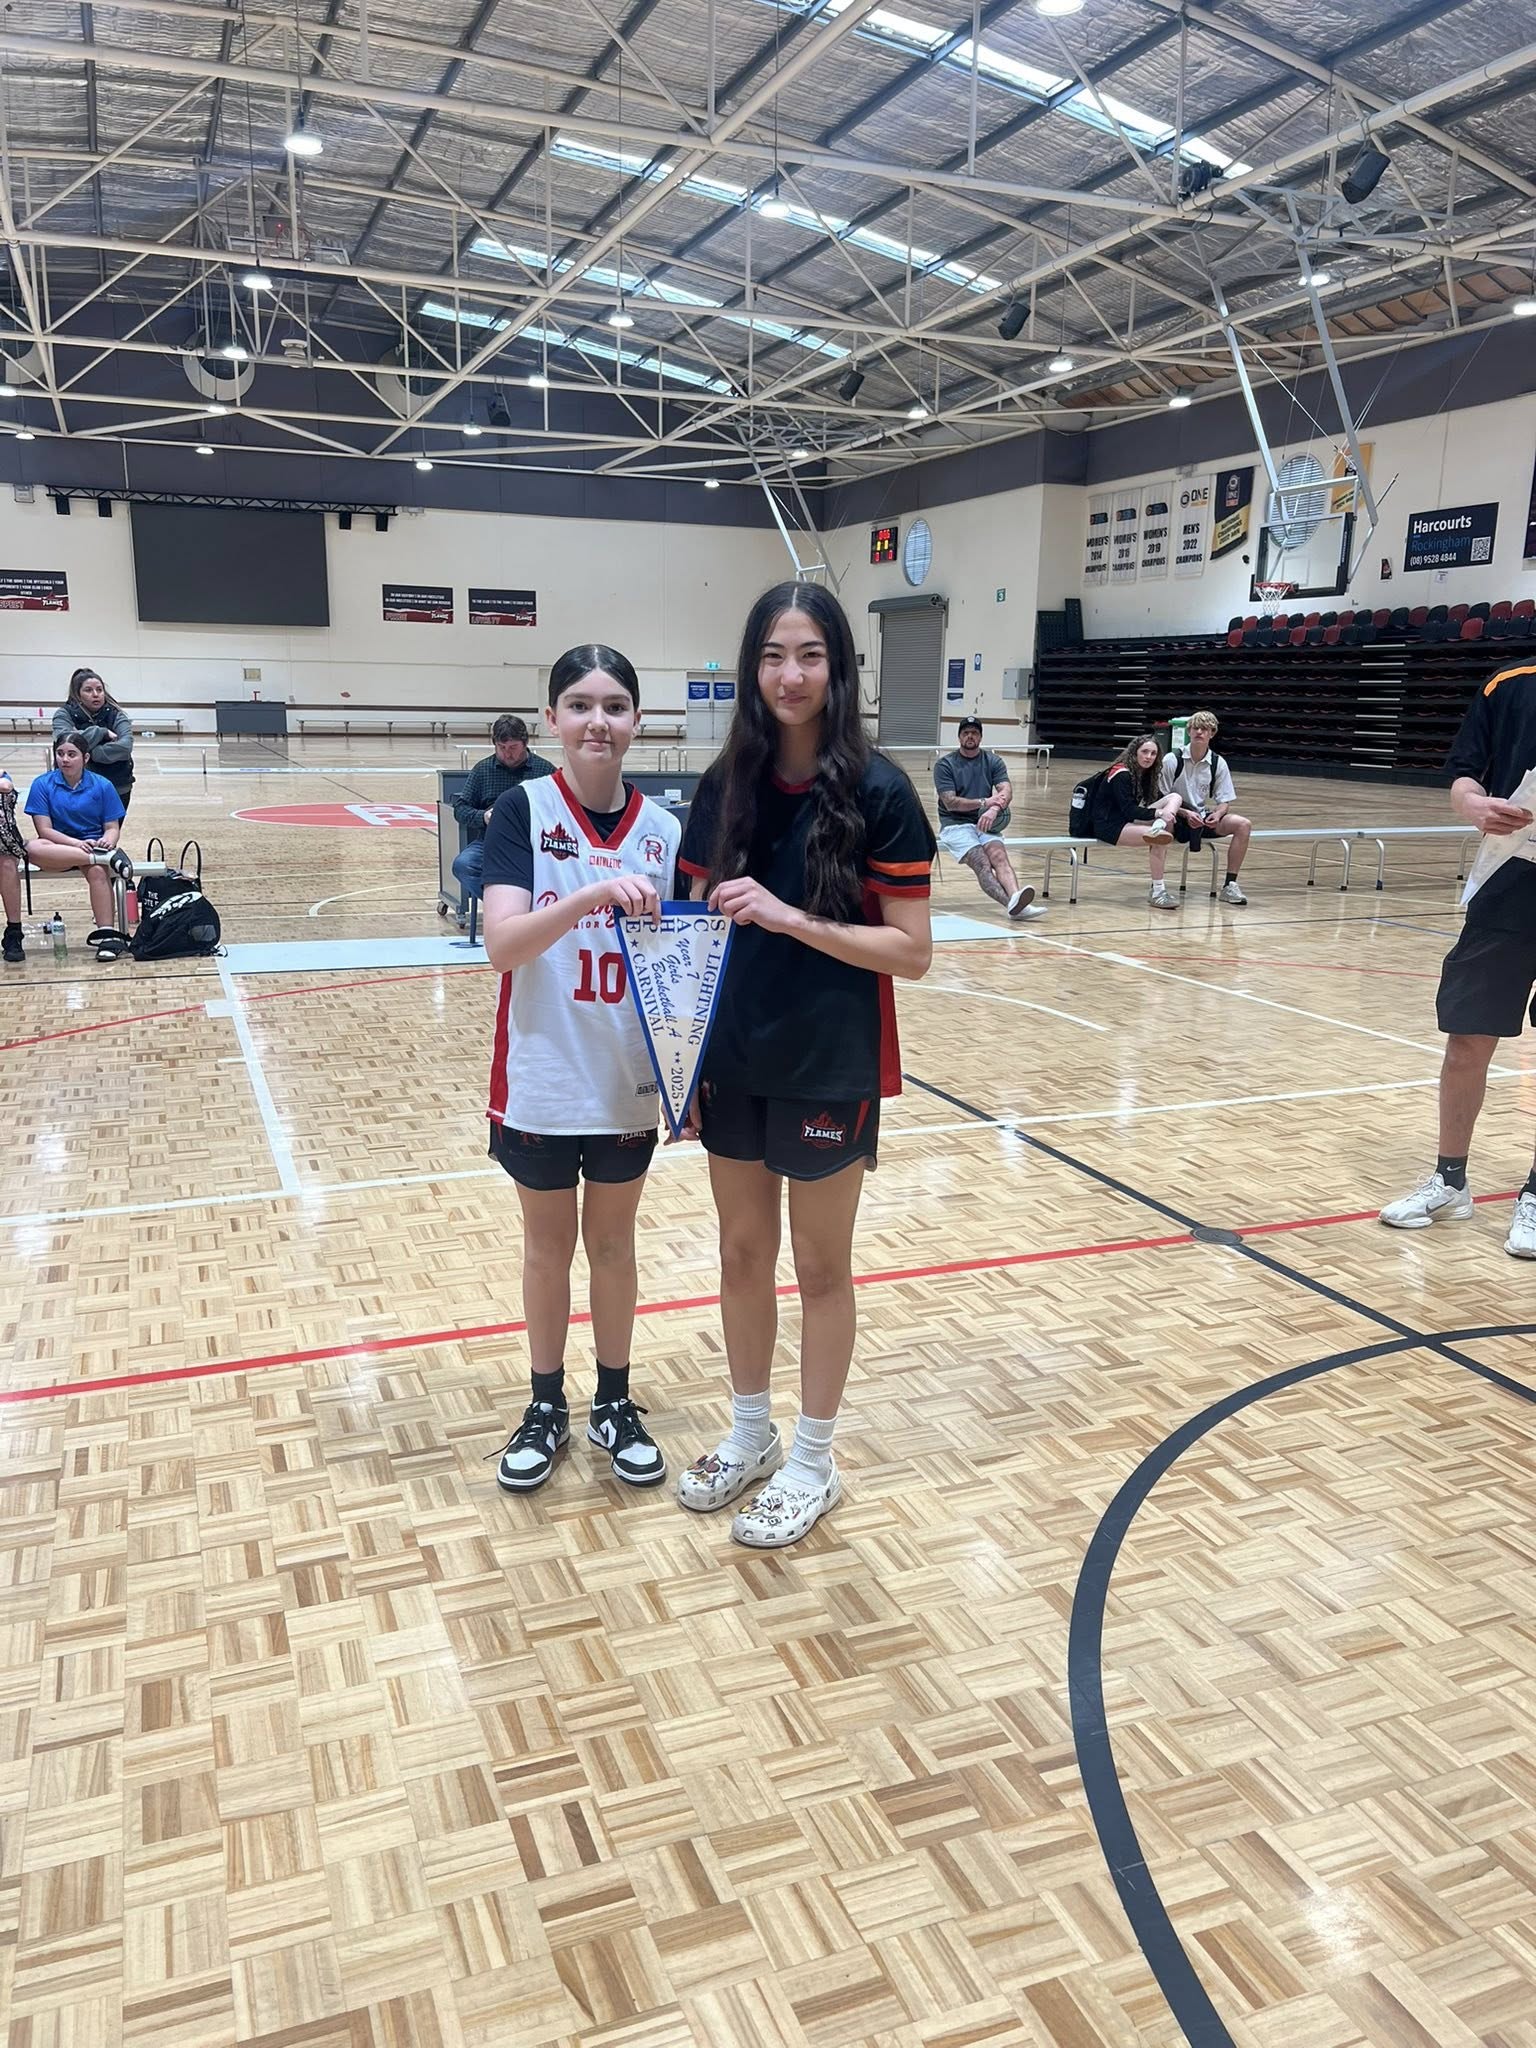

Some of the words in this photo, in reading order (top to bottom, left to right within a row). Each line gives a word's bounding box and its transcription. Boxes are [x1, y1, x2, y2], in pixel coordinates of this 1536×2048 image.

[1183, 523, 1200, 535] MEN'S
[1413, 515, 1472, 534] Harcourts
[1113, 533, 1137, 544] WOMEN'S
[1143, 527, 1168, 540] WOMEN'S
[1086, 536, 1109, 548] WOMEN'S
[1182, 539, 1198, 550] 2022
[1411, 536, 1471, 552] Rockingham
[1112, 562, 1135, 571] CHAMPIONS
[1141, 557, 1166, 567] CHAMPIONS
[1175, 554, 1202, 564] CHAMPIONS
[1410, 556, 1423, 566] (08)
[1423, 554, 1440, 564] 9528
[1440, 552, 1457, 562] 4844
[543, 836, 578, 854] FLAMES
[675, 938, 692, 967] Year
[687, 971, 700, 980] 7
[573, 948, 627, 1004] 10
[662, 954, 683, 984] Girls
[633, 953, 665, 1036] CARNIVAL
[652, 961, 679, 1024] Basketball
[667, 1026, 682, 1038] A
[688, 953, 721, 1045] LIGHTNING
[671, 1067, 684, 1099] 2025
[804, 1125, 843, 1142] FLAMES
